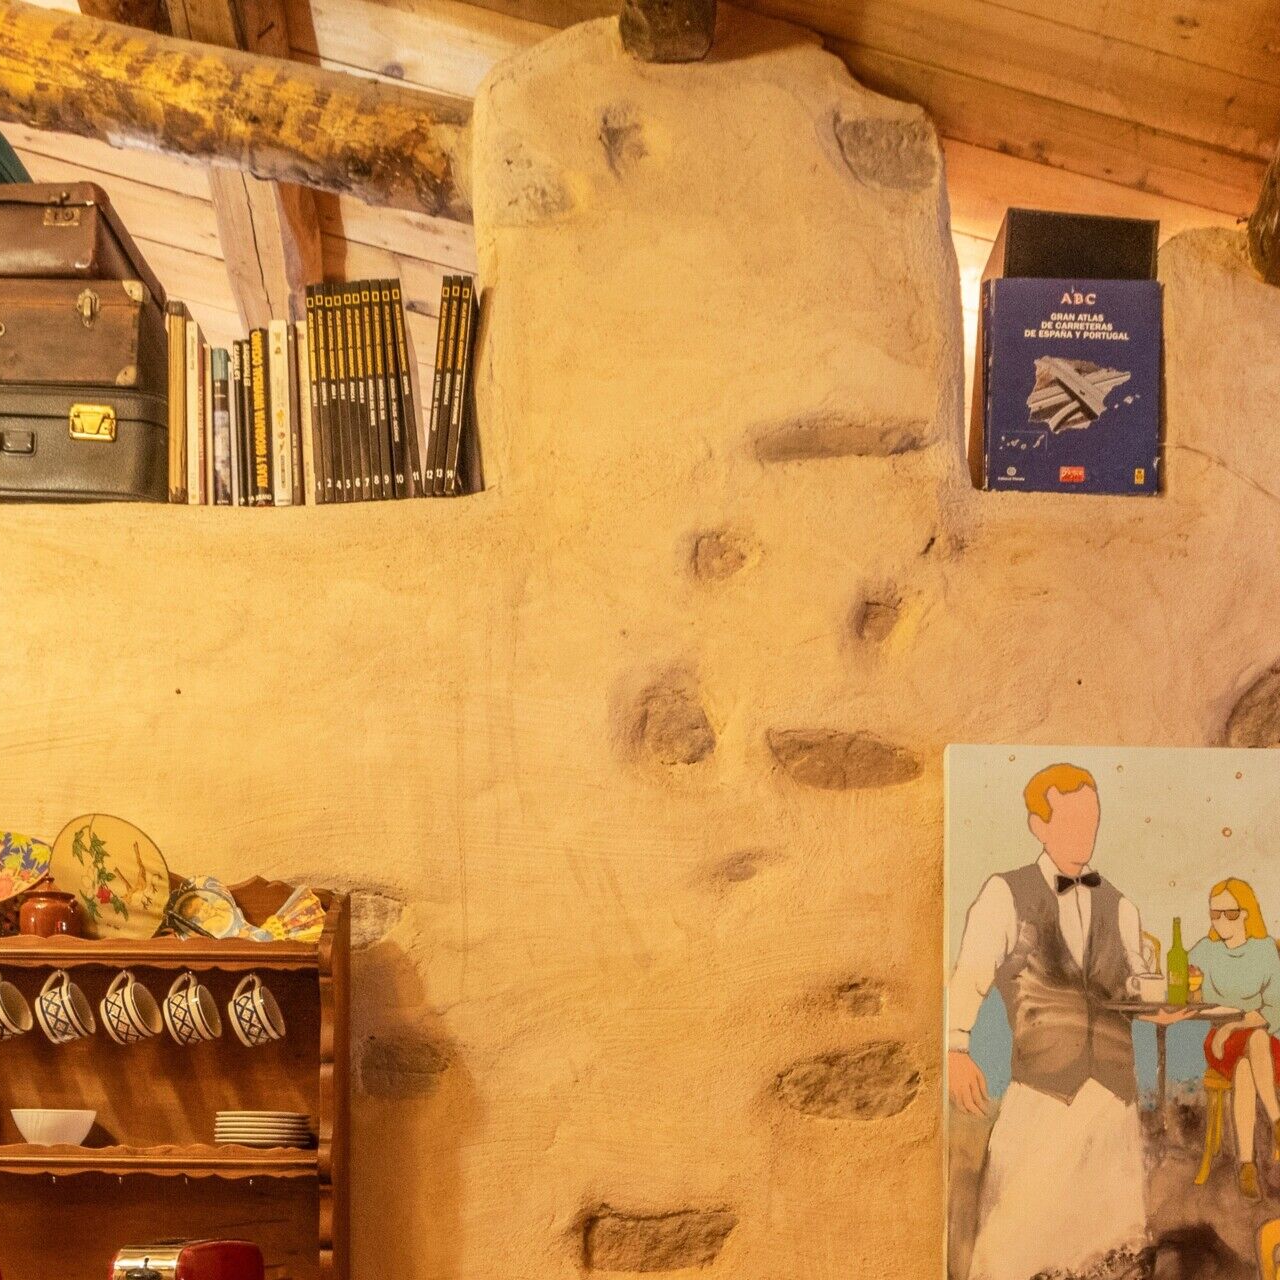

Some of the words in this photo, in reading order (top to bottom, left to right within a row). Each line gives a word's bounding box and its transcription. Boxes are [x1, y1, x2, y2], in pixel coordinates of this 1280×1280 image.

[1061, 293, 1096, 305] ABC
[1051, 313, 1074, 321] GRAN
[1078, 314, 1103, 322] ATLAS
[1055, 322, 1113, 330] CARRETERAS
[1039, 330, 1072, 338] ESPAÑA
[1083, 332, 1129, 340] PORTUGAL
[251, 331, 263, 365] OCEANO
[234, 370, 240, 380] La
[244, 378, 250, 386] El
[252, 366, 264, 409] UNIVERSAL
[257, 464, 268, 488] ATLAS
[413, 472, 419, 480] 11
[426, 470, 433, 479] 12
[436, 469, 443, 478] 13
[447, 470, 453, 479] 14
[327, 478, 331, 488] 2
[346, 479, 350, 489] 5
[355, 478, 360, 487] 6
[365, 477, 369, 487] 7
[374, 475, 379, 485] 8
[384, 475, 389, 485] 9
[397, 474, 403, 484] 10
[318, 482, 321, 490] 1
[336, 480, 341, 489] 4
